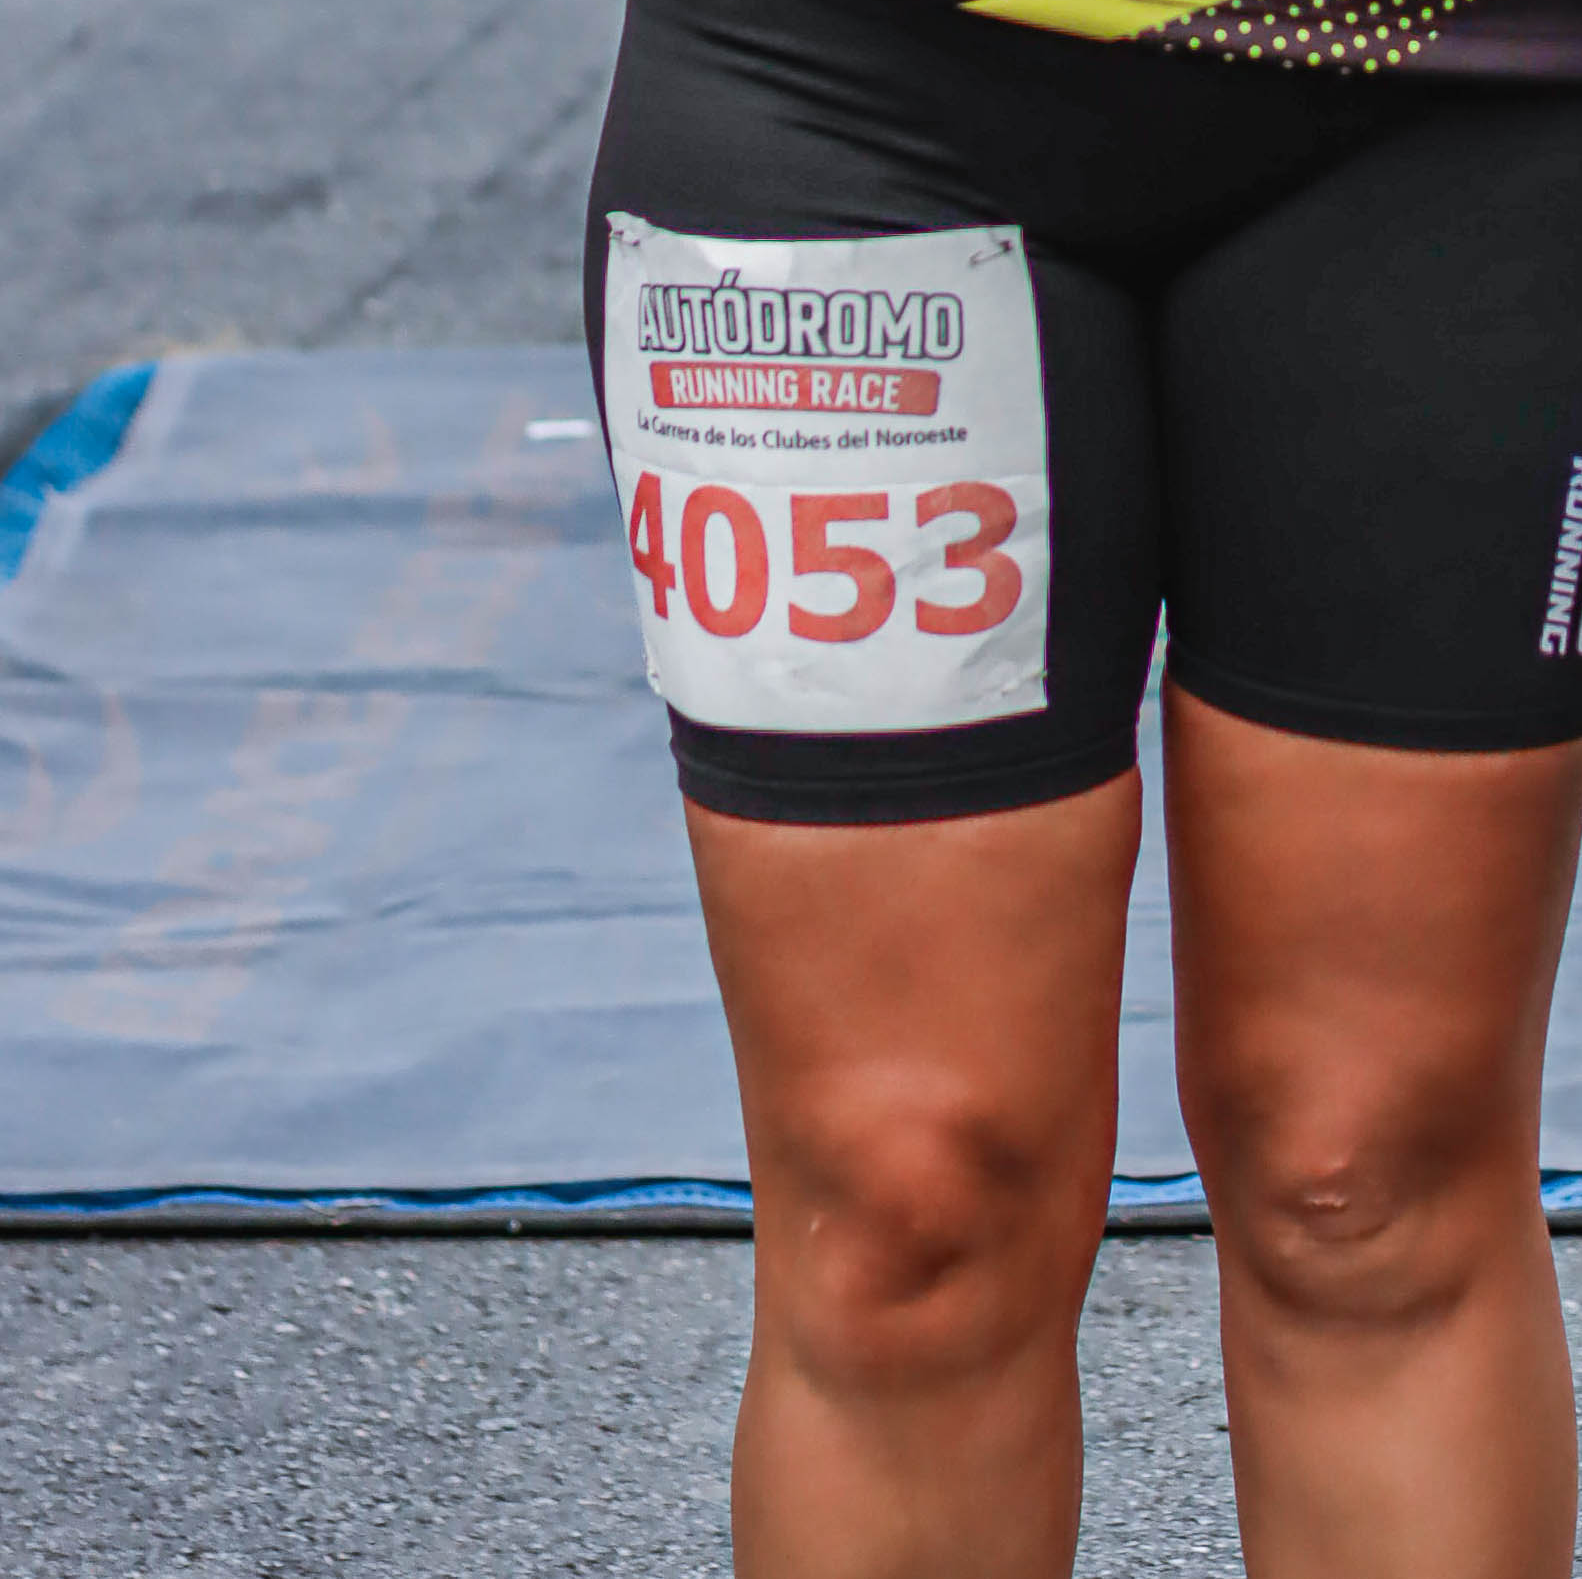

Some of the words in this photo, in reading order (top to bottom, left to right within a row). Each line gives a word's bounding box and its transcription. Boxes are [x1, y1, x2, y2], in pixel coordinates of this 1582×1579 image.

[638, 269, 965, 360] AUTÓDROMO
[668, 368, 799, 407] RUNNING
[811, 373, 901, 411] RACE
[637, 408, 649, 429] La
[652, 415, 700, 443] Carrera
[704, 426, 726, 447] de
[730, 427, 757, 449] los
[761, 429, 831, 450] Clubes
[837, 429, 869, 450] del
[876, 424, 968, 448] Noroeste
[629, 470, 1023, 643] 4053
